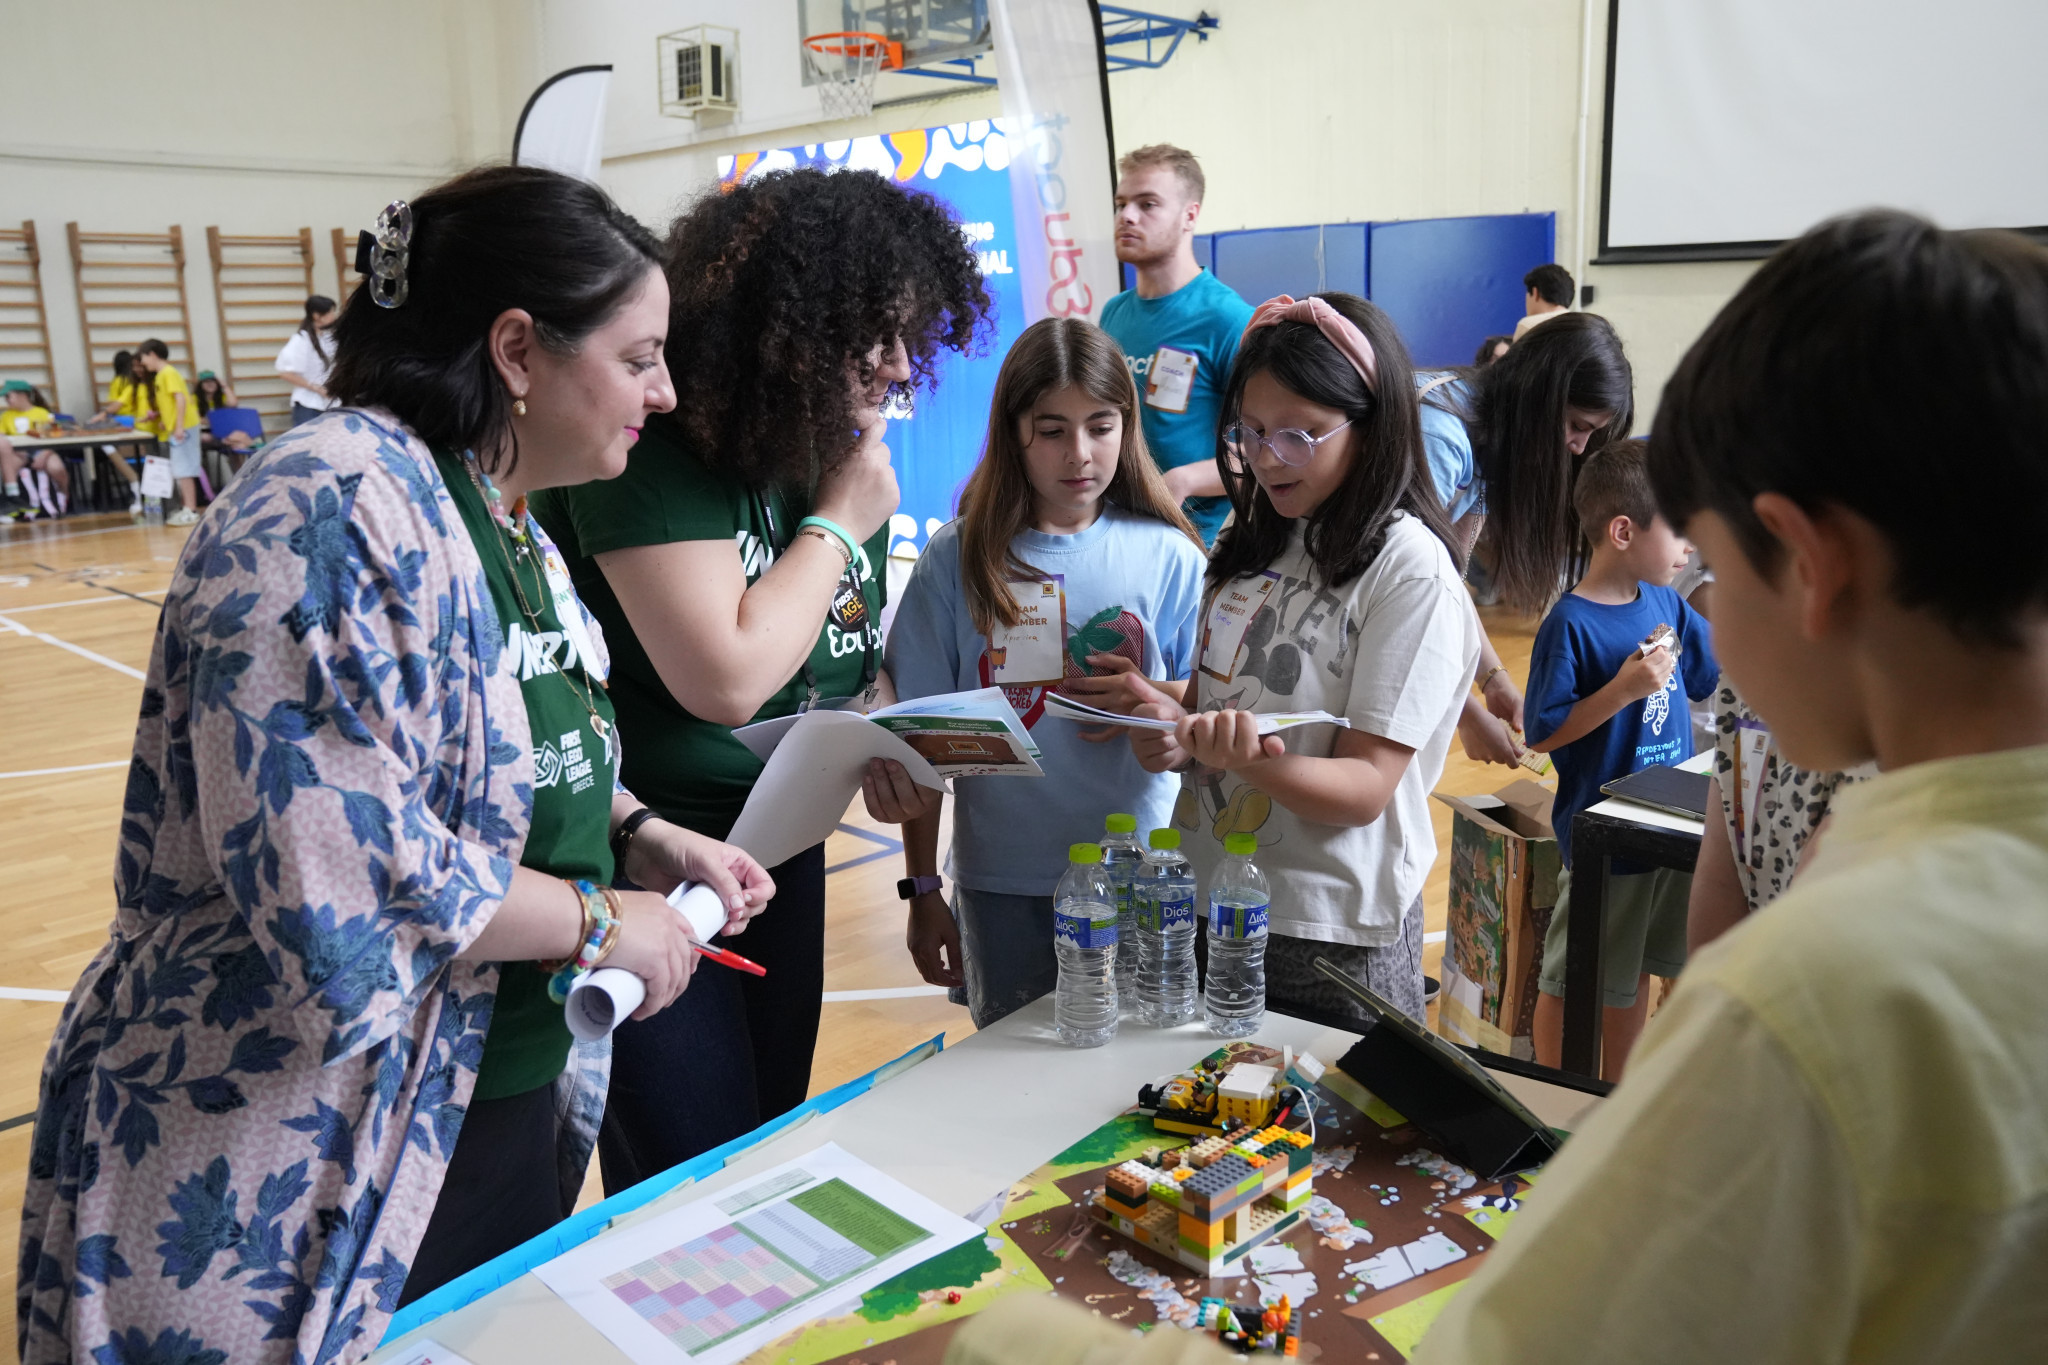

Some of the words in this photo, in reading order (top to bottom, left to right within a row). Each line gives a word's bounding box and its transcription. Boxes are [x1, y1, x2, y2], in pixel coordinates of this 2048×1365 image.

[834, 588, 855, 610] FIRST
[1230, 592, 1249, 604] TEAM
[841, 596, 863, 620] AGE
[1018, 605, 1038, 614] EAM
[1220, 602, 1246, 616] MEMBER
[1015, 617, 1048, 627] EMBER
[572, 775, 595, 795] GREECE
[1163, 906, 1189, 919] Dios
[1055, 916, 1075, 935] Διός
